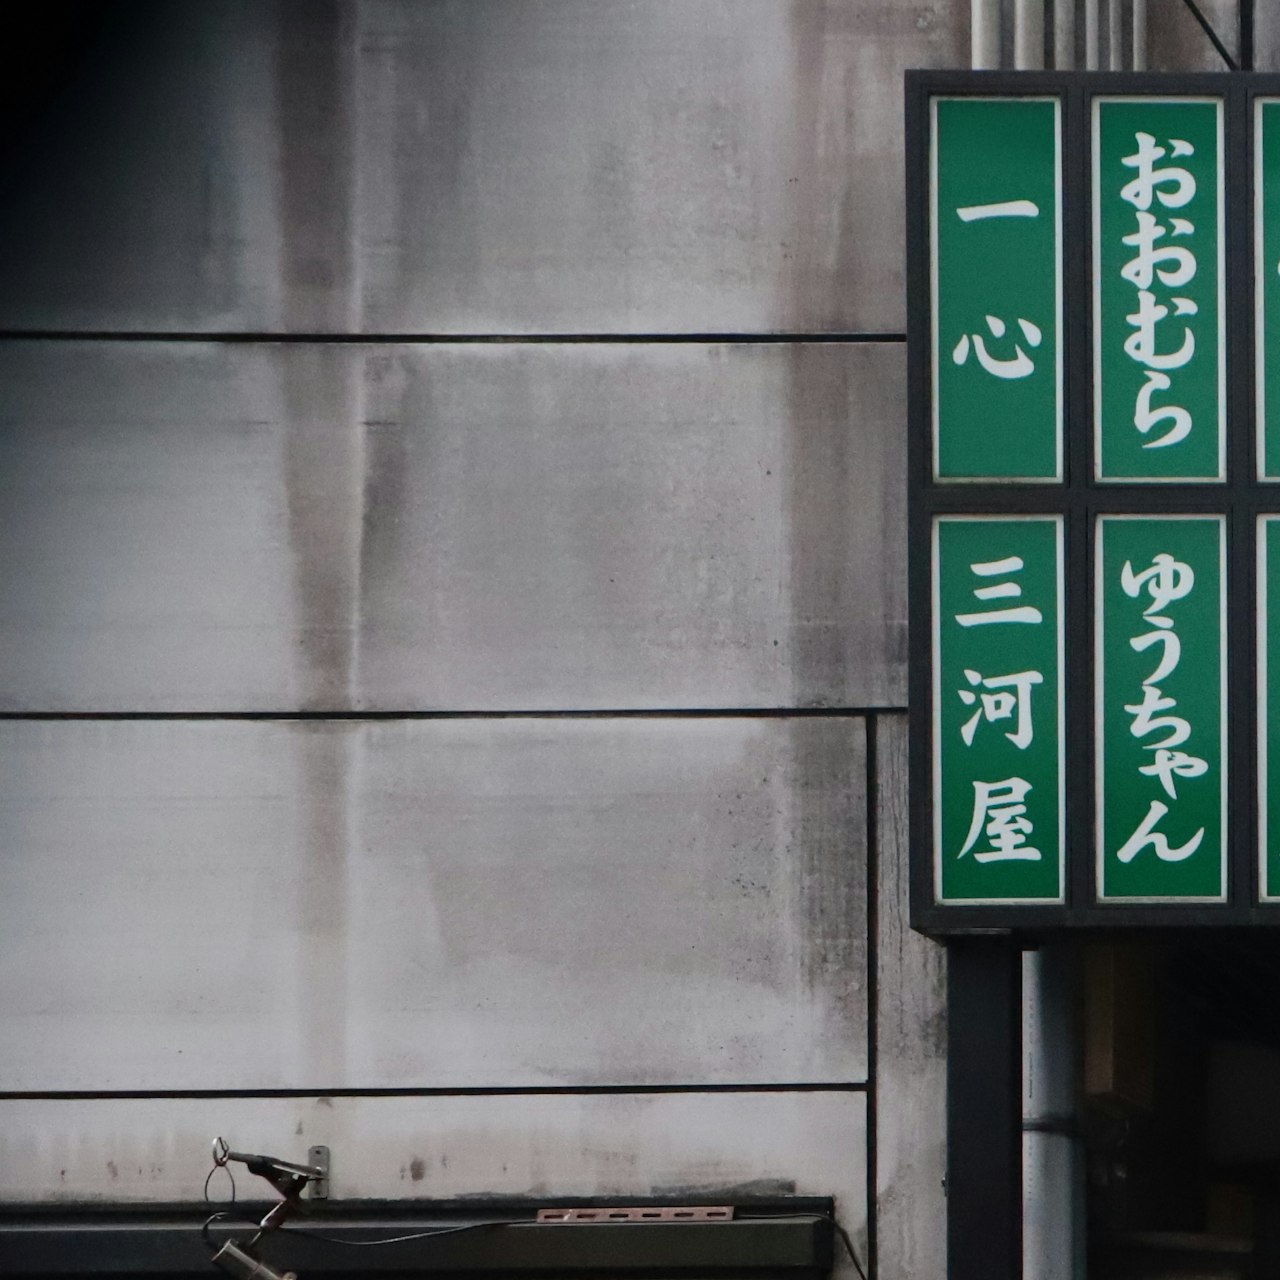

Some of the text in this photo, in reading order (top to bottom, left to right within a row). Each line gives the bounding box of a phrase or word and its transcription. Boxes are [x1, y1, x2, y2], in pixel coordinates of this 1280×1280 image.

[952, 200, 1042, 379] 一心
[1120, 132, 1198, 448] おおむら
[955, 556, 1043, 863] 三河屋
[1116, 553, 1208, 862] ゆうちゃん
